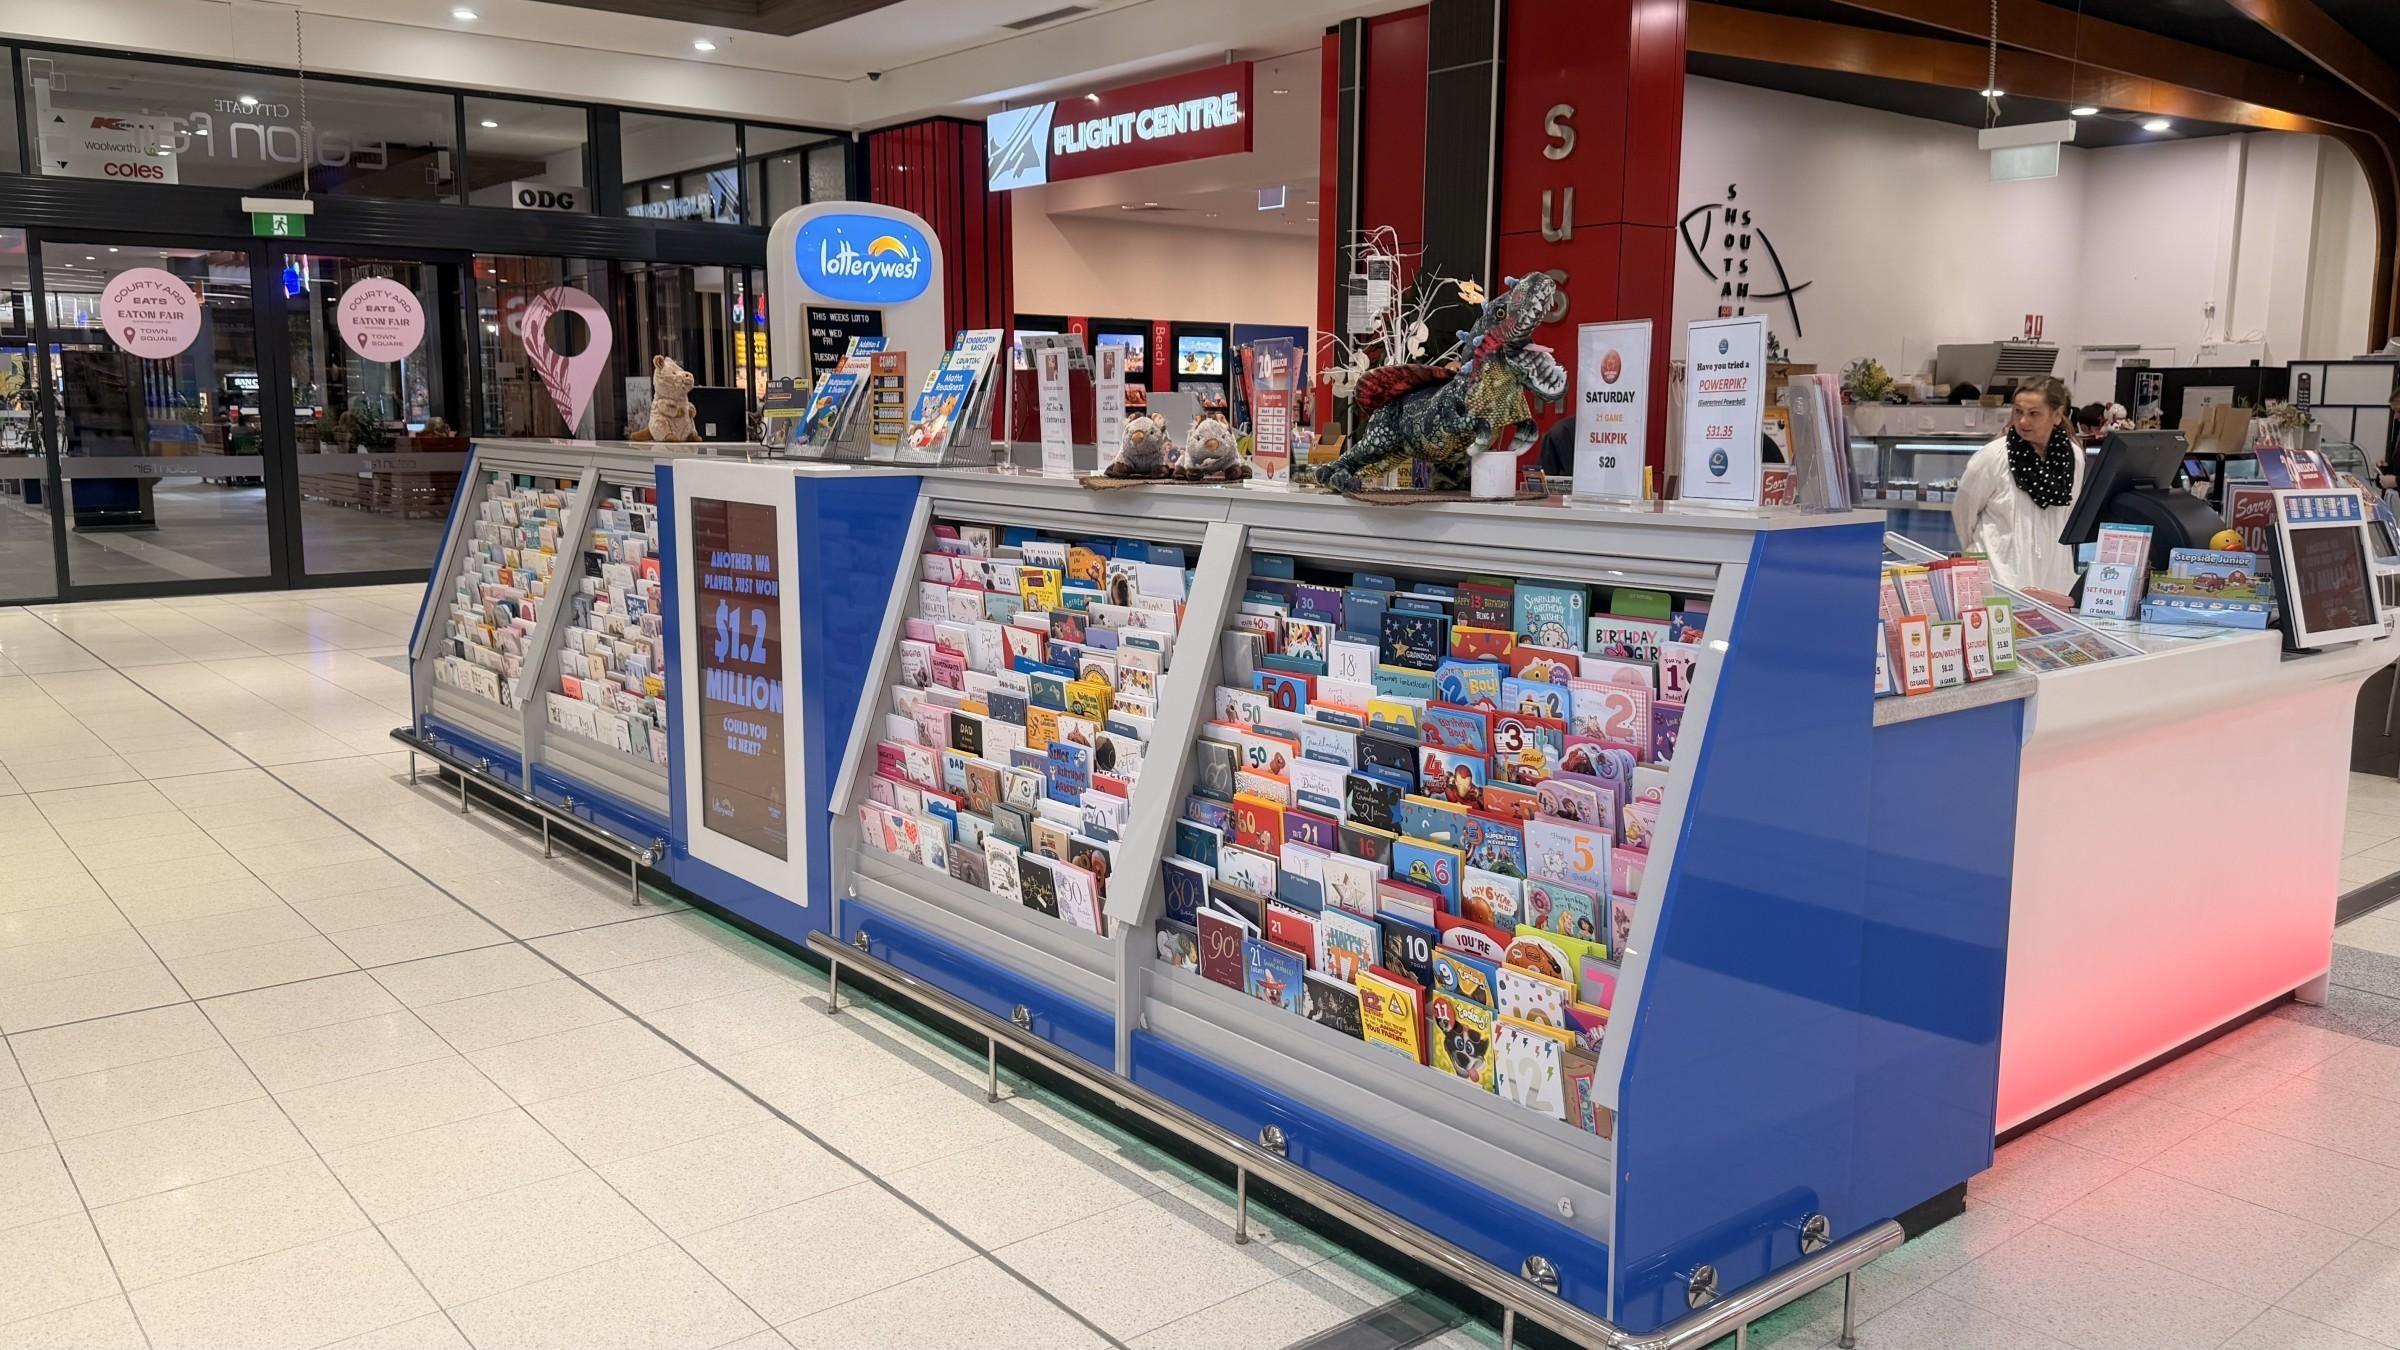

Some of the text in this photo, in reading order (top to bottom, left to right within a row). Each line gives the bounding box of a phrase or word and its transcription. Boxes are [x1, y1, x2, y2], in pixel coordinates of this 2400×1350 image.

[1053, 91, 1238, 156] FLIGHT CENTRE
[104, 161, 164, 180] coles
[518, 188, 575, 210] ODG
[821, 237, 922, 284] lotterywest
[113, 281, 186, 305] COURTYARD
[133, 297, 168, 305] EATS
[349, 289, 413, 313] COURTYARD
[117, 309, 185, 321] EATON FAIR
[366, 305, 396, 313] EATS
[352, 317, 411, 327] EATON FAIR
[812, 312, 870, 323] THIS WEEKS LOTTO
[140, 335, 178, 343] SQUARE
[371, 333, 397, 341] TOWN
[812, 328, 842, 337] MON WED
[371, 340, 404, 348] SQUARE
[823, 337, 833, 345] FRI
[1155, 326, 1166, 366] Beach
[814, 353, 838, 362] TUESDAY
[880, 355, 897, 368] COMBO
[1697, 361, 1713, 372] Have
[1714, 363, 1727, 372] you
[1728, 361, 1744, 370] tried
[944, 373, 963, 382] Maths
[1699, 377, 1747, 392] POWERPIK?
[935, 383, 964, 391] Readiness
[1585, 391, 1635, 403] SATURDAY
[1595, 414, 1624, 422] 21 GAME
[1590, 432, 1628, 445] SLIKPIK
[1706, 425, 1733, 439] $31.35
[1598, 455, 1616, 469] $20
[2236, 497, 2272, 519] Sorry
[711, 552, 771, 573] ANOTHER WA
[2175, 552, 2250, 567] Stepside Junior
[704, 574, 779, 597] PLAYER JUST WON
[2086, 586, 2127, 597] SET FOR LIFE
[1301, 598, 1314, 610] 30
[1471, 594, 1482, 609] 13
[1524, 593, 1562, 610] SPARKLING
[1534, 603, 1565, 614] BIRTHDAY
[2095, 598, 2113, 606] $9.45
[1253, 618, 1264, 630] 40
[1475, 611, 1496, 622] BEING A
[1540, 613, 1564, 622] WISHES
[714, 598, 767, 665] $1.2
[1596, 628, 1657, 644] BIRTHDAY
[1992, 626, 2010, 635] TUESDAY
[1967, 640, 1987, 650] SATURDAY
[1406, 650, 1437, 662] GRANDSON
[1667, 664, 1682, 692] 1
[1912, 665, 1926, 675] $6.70
[705, 667, 784, 714] MILLION
[1262, 676, 1297, 713] 50
[1442, 675, 1499, 706] 2 Boy!
[1546, 692, 1563, 718] 2
[1242, 702, 1261, 725] 50
[1605, 693, 1634, 738] 2
[723, 716, 768, 741] COULD YOU
[960, 723, 973, 736] DAD
[1440, 719, 1475, 731] Birthday
[1447, 727, 1468, 740] Boy!
[1504, 724, 1524, 753] 3
[727, 736, 762, 757] BE NEXT?
[949, 757, 964, 771] DAD
[1249, 746, 1267, 769] 50
[1423, 752, 1444, 779] 4
[1521, 753, 1544, 763] Today!
[1189, 801, 1201, 818] 60
[1360, 803, 1374, 822] 21
[1236, 808, 1256, 834] 60
[1302, 823, 1319, 845] 21
[1468, 824, 1479, 841] 5
[1485, 833, 1518, 842] SUPER-COOL
[1359, 837, 1376, 858] 16
[1573, 835, 1594, 873] 5
[1433, 858, 1451, 886] 6
[1063, 879, 1082, 906] 90
[1167, 872, 1195, 911] 80
[1485, 886, 1494, 898] 6
[1271, 919, 1282, 934] 21
[1208, 927, 1235, 960] 90
[1406, 935, 1429, 963] 10
[1454, 934, 1491, 955] YOU'RE
[1250, 946, 1261, 967] 21
[1329, 945, 1360, 984] 17
[1411, 961, 1427, 969] TODAY
[1439, 963, 1453, 987] 9
[1585, 969, 1617, 1010] 7
[1434, 1002, 1489, 1029] 11 today!
[1504, 1054, 1555, 1112] 12
